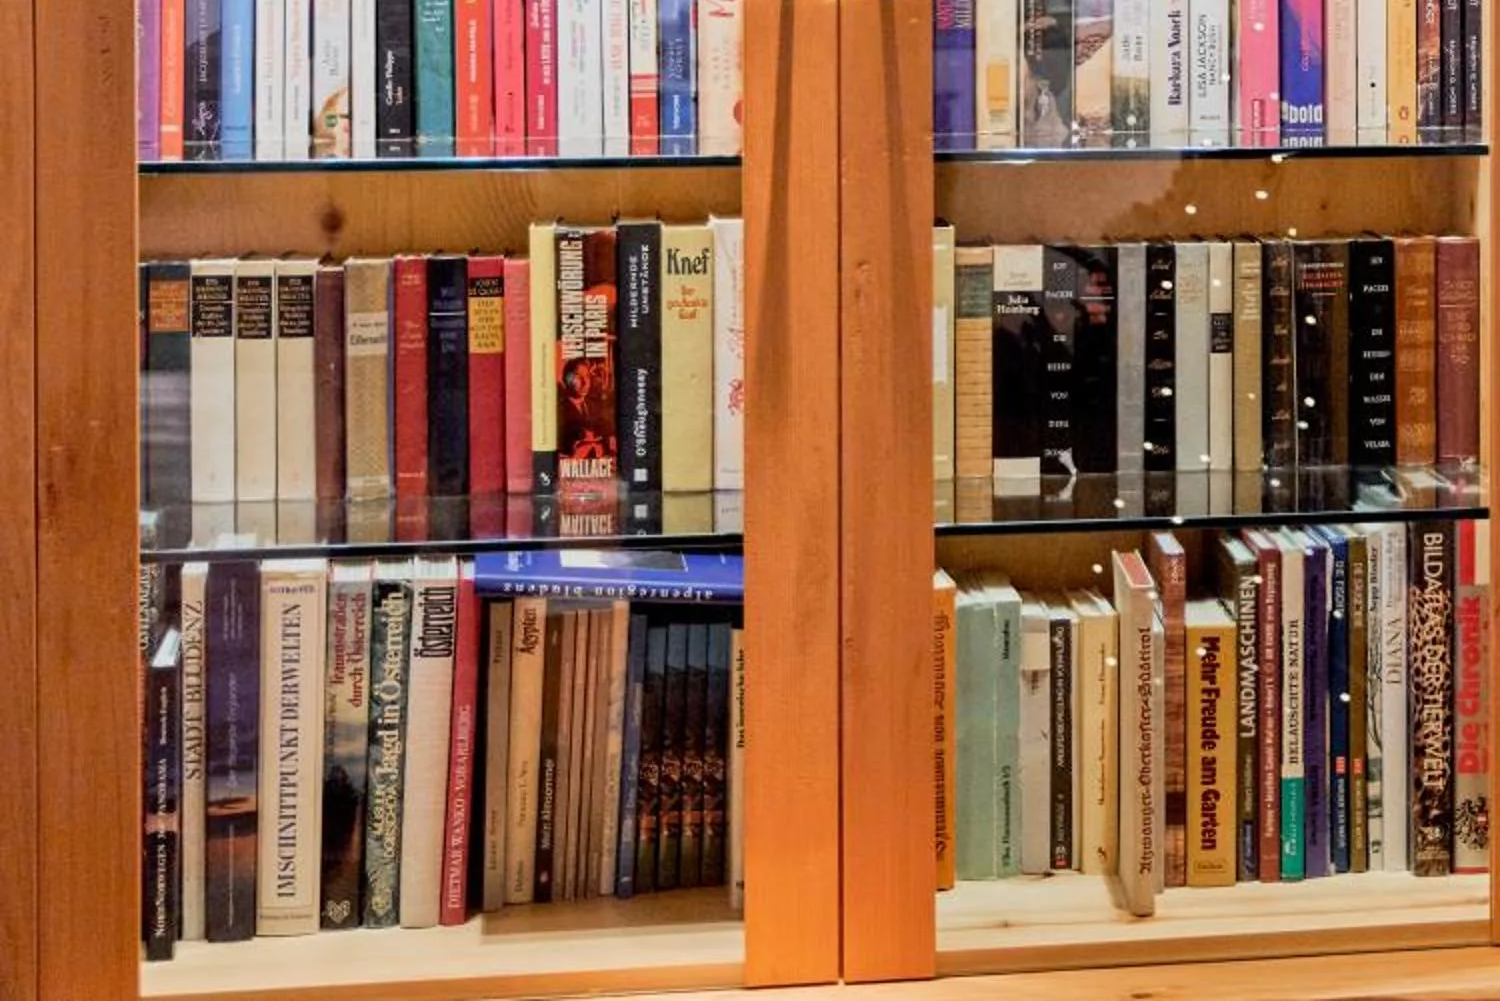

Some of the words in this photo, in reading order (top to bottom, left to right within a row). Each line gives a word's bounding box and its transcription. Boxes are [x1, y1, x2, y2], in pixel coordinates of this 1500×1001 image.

[1197, 14, 1207, 70] JACKSON
[1197, 73, 1207, 99] LISA
[666, 247, 712, 276] Knef
[557, 239, 584, 360] VERSCHWÖRUNG
[584, 294, 609, 339] PARIS
[1007, 294, 1029, 305] Julia
[584, 340, 608, 360] IN
[559, 457, 614, 479] WALLACE
[502, 582, 583, 597] bludenz
[594, 584, 714, 599] alpenregion
[1422, 532, 1444, 640] BILDATLAS
[345, 591, 367, 665] Österreich
[374, 591, 404, 702] Österreich
[413, 586, 455, 659] Österreich
[515, 608, 539, 655] Ägypten
[1287, 618, 1299, 667] NATUR
[185, 600, 204, 703] BLUDENZ
[1199, 634, 1221, 686] Mehr
[1240, 576, 1259, 738] LANDMASCHINEN
[1385, 618, 1403, 685] DIANA
[1422, 644, 1444, 686] DER
[1456, 596, 1481, 717] Chronik
[345, 670, 364, 709] durch
[377, 704, 400, 725] in
[1199, 686, 1220, 753] Freude
[1287, 670, 1299, 765] BELAUSCHTE
[1422, 690, 1444, 790] TIERWELT
[185, 713, 203, 781] STADT
[375, 729, 402, 781] Jagd
[1199, 759, 1217, 782] am
[1456, 722, 1481, 774] Die
[1199, 784, 1218, 851] Garten
